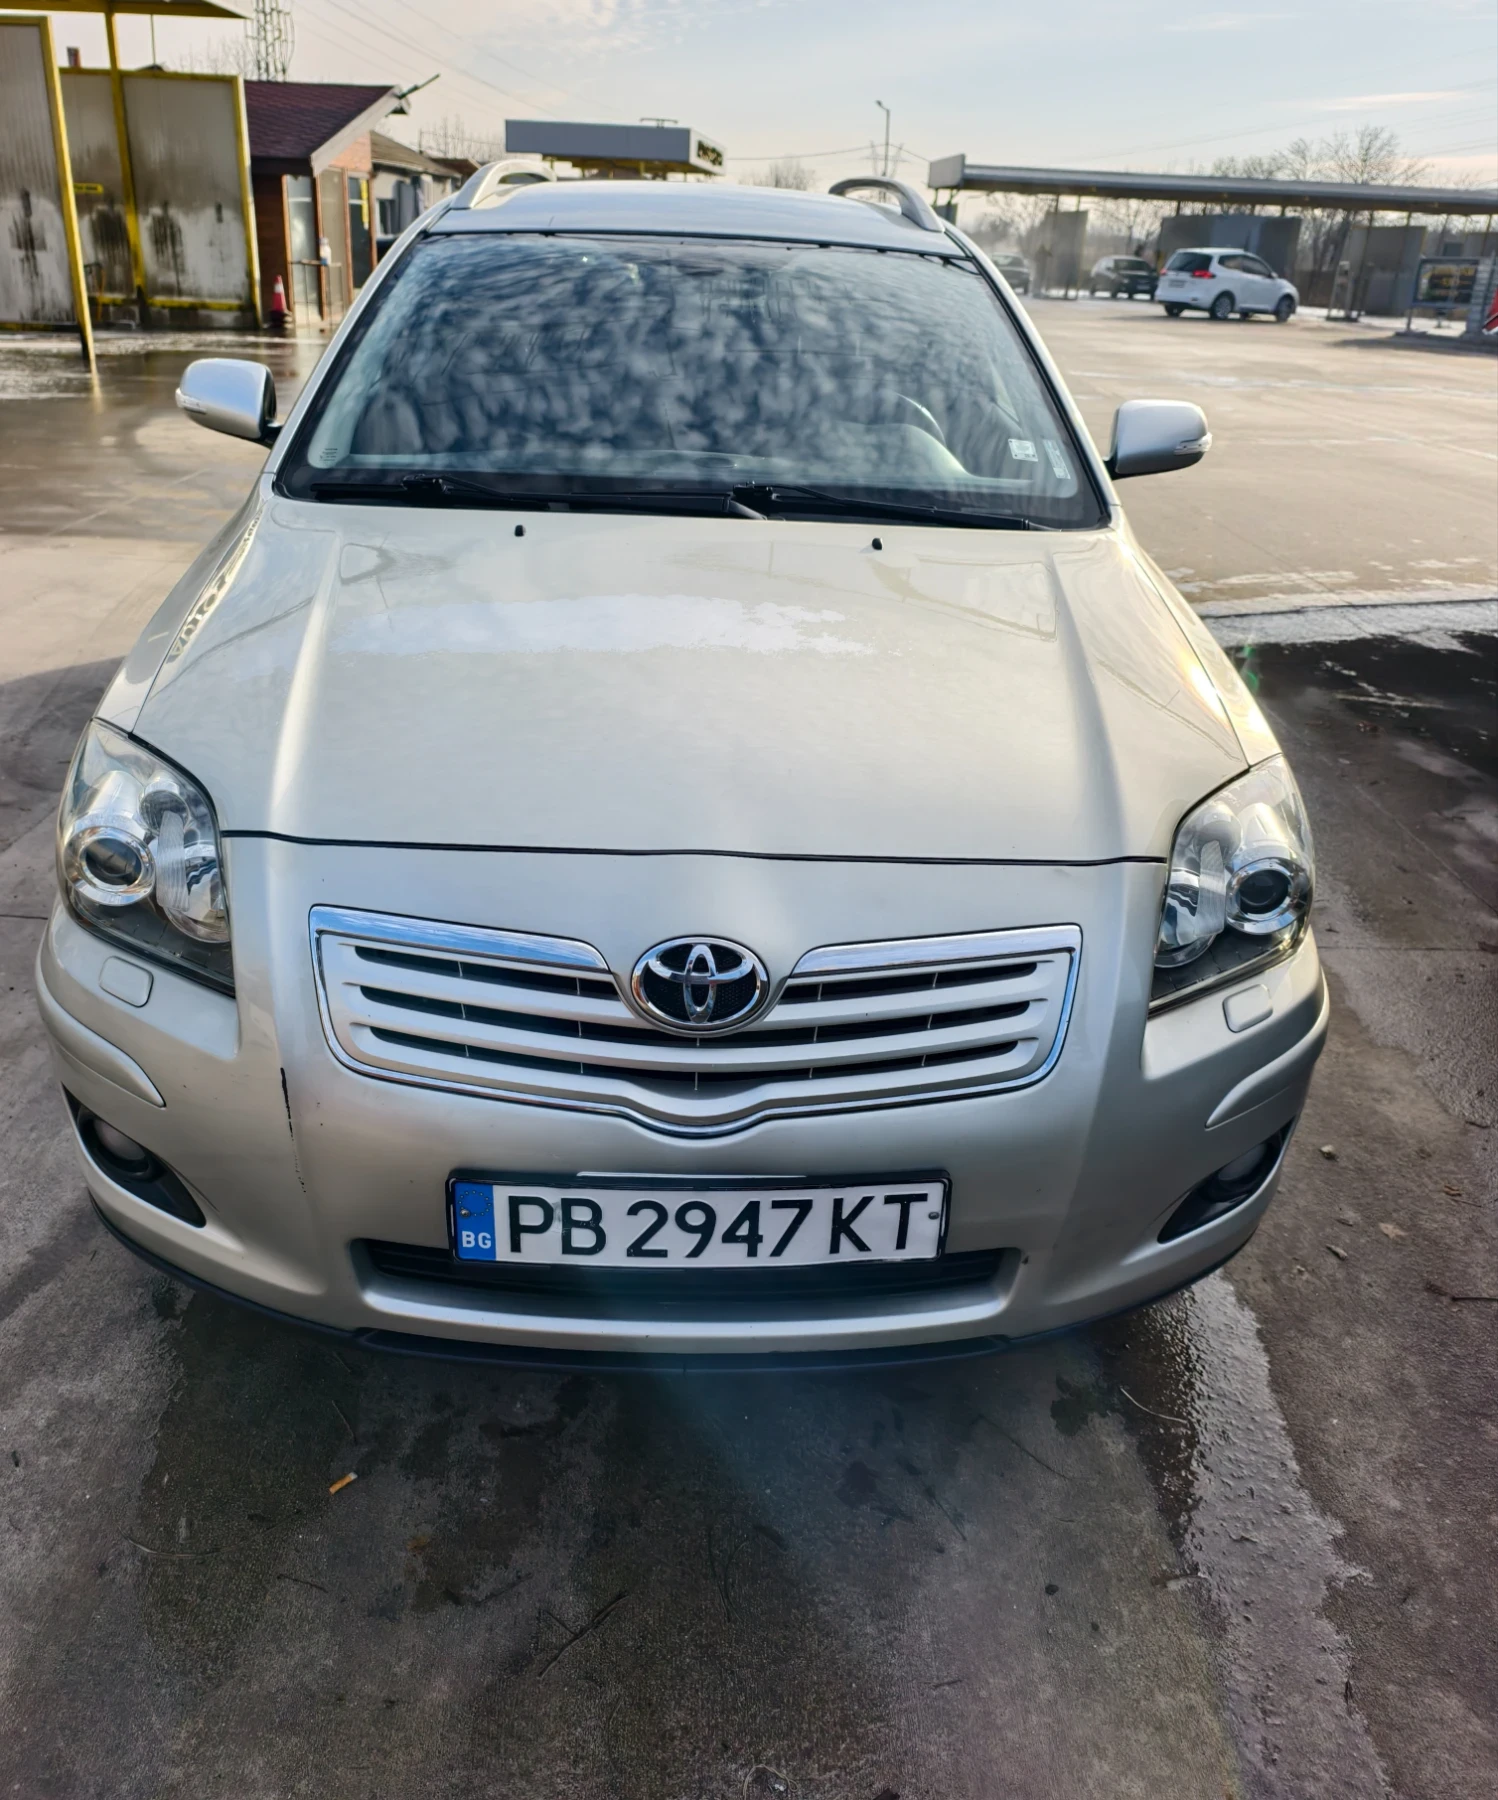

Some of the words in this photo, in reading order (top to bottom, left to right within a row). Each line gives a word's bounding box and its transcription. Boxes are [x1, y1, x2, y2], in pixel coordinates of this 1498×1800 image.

[461, 1231, 492, 1249] BG
[508, 1195, 607, 1256] PB
[626, 1199, 814, 1259] 2947
[829, 1193, 929, 1255] KT
